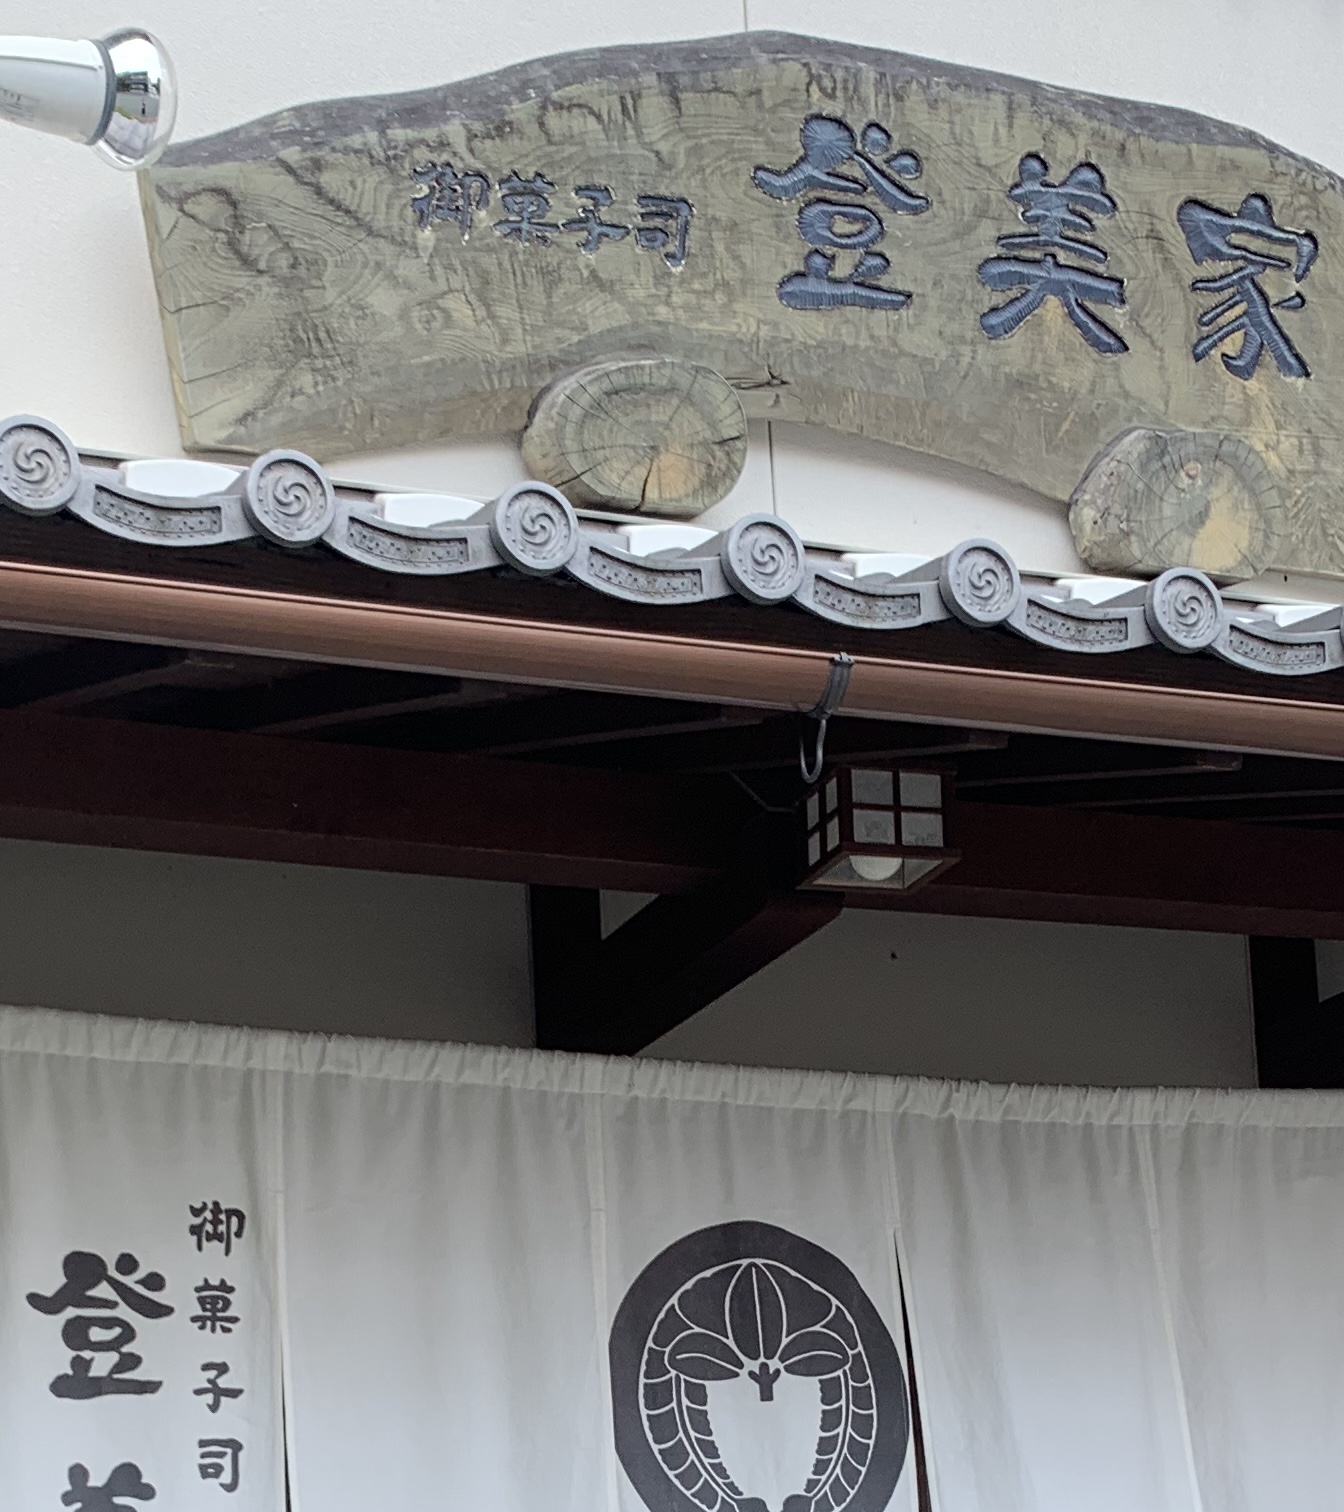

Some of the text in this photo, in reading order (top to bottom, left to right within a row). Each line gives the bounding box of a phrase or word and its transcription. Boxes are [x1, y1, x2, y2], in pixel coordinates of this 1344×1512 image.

[411, 114, 1320, 381] 御菓子司 登美家
[188, 1200, 246, 1493] 御菓子司
